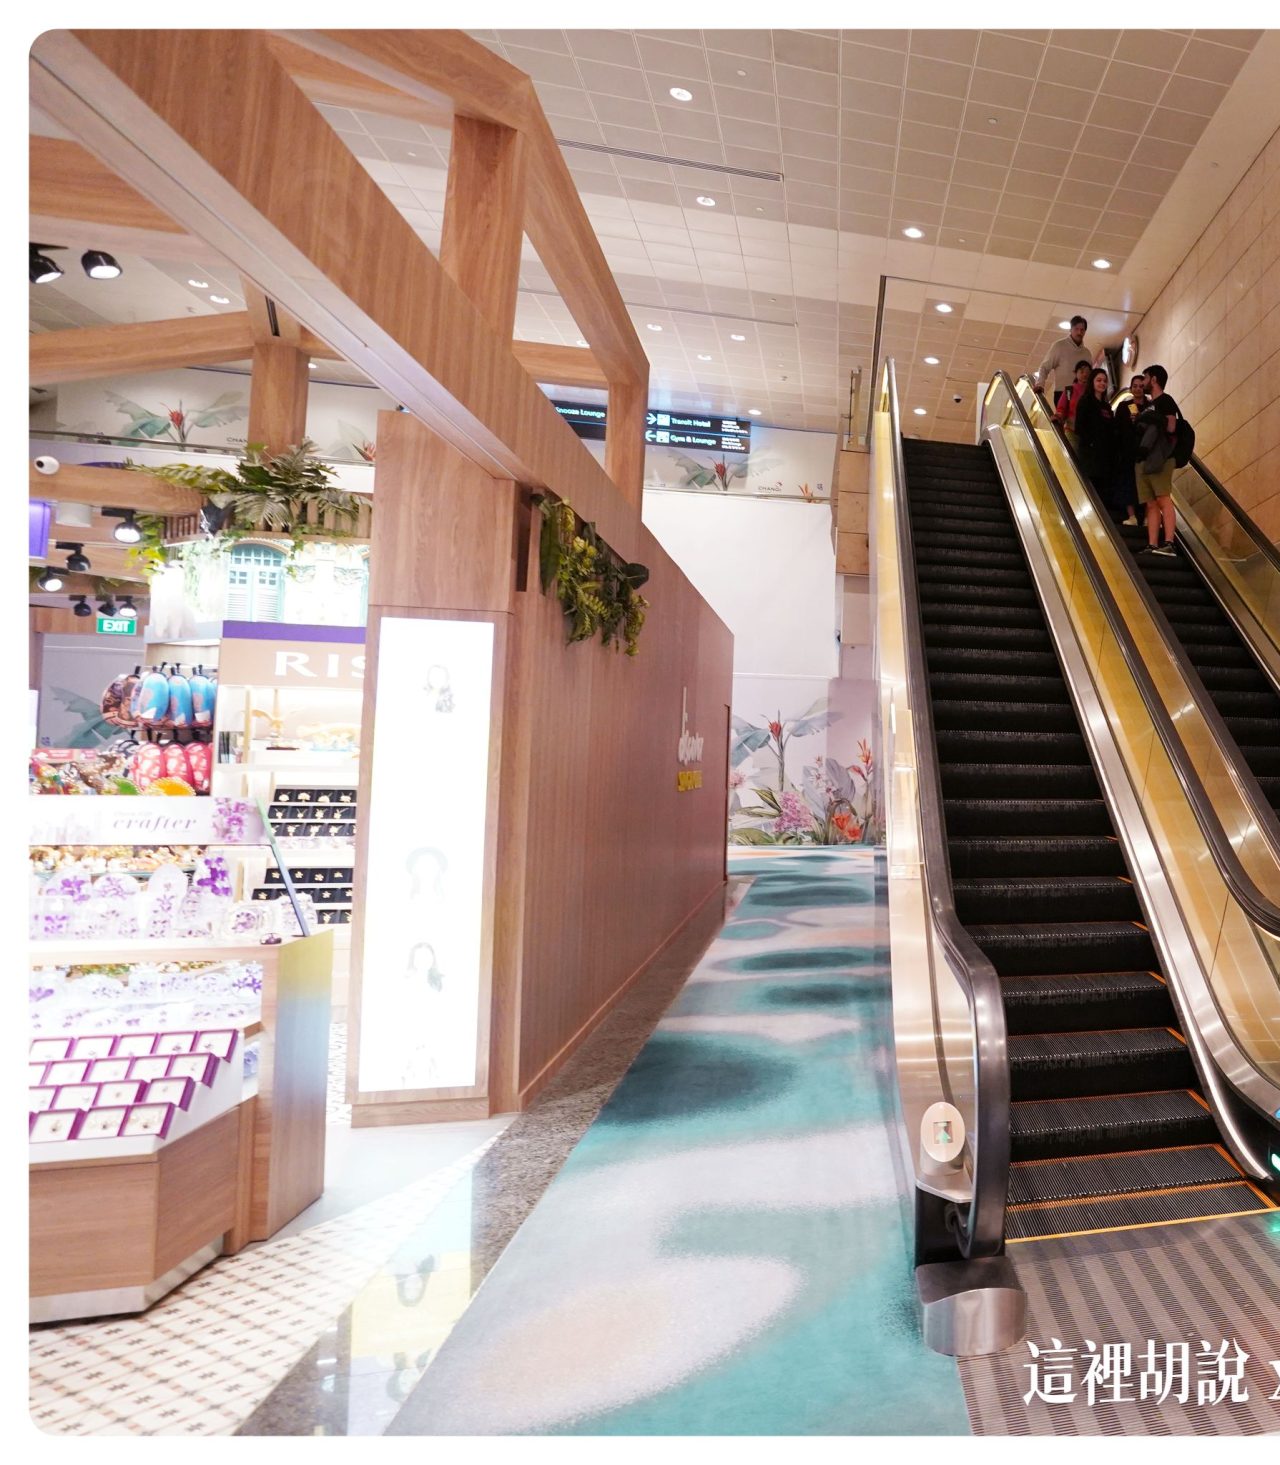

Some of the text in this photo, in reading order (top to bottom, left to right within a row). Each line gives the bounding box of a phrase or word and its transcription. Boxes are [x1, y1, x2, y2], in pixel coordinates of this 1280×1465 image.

[580, 409, 606, 418] Lounge
[671, 417, 692, 426] Transit
[693, 420, 711, 428] Hotel
[670, 434, 686, 443] Gym
[692, 437, 717, 446] Lounge
[103, 619, 129, 632] EXIT
[113, 815, 197, 832] crafter
